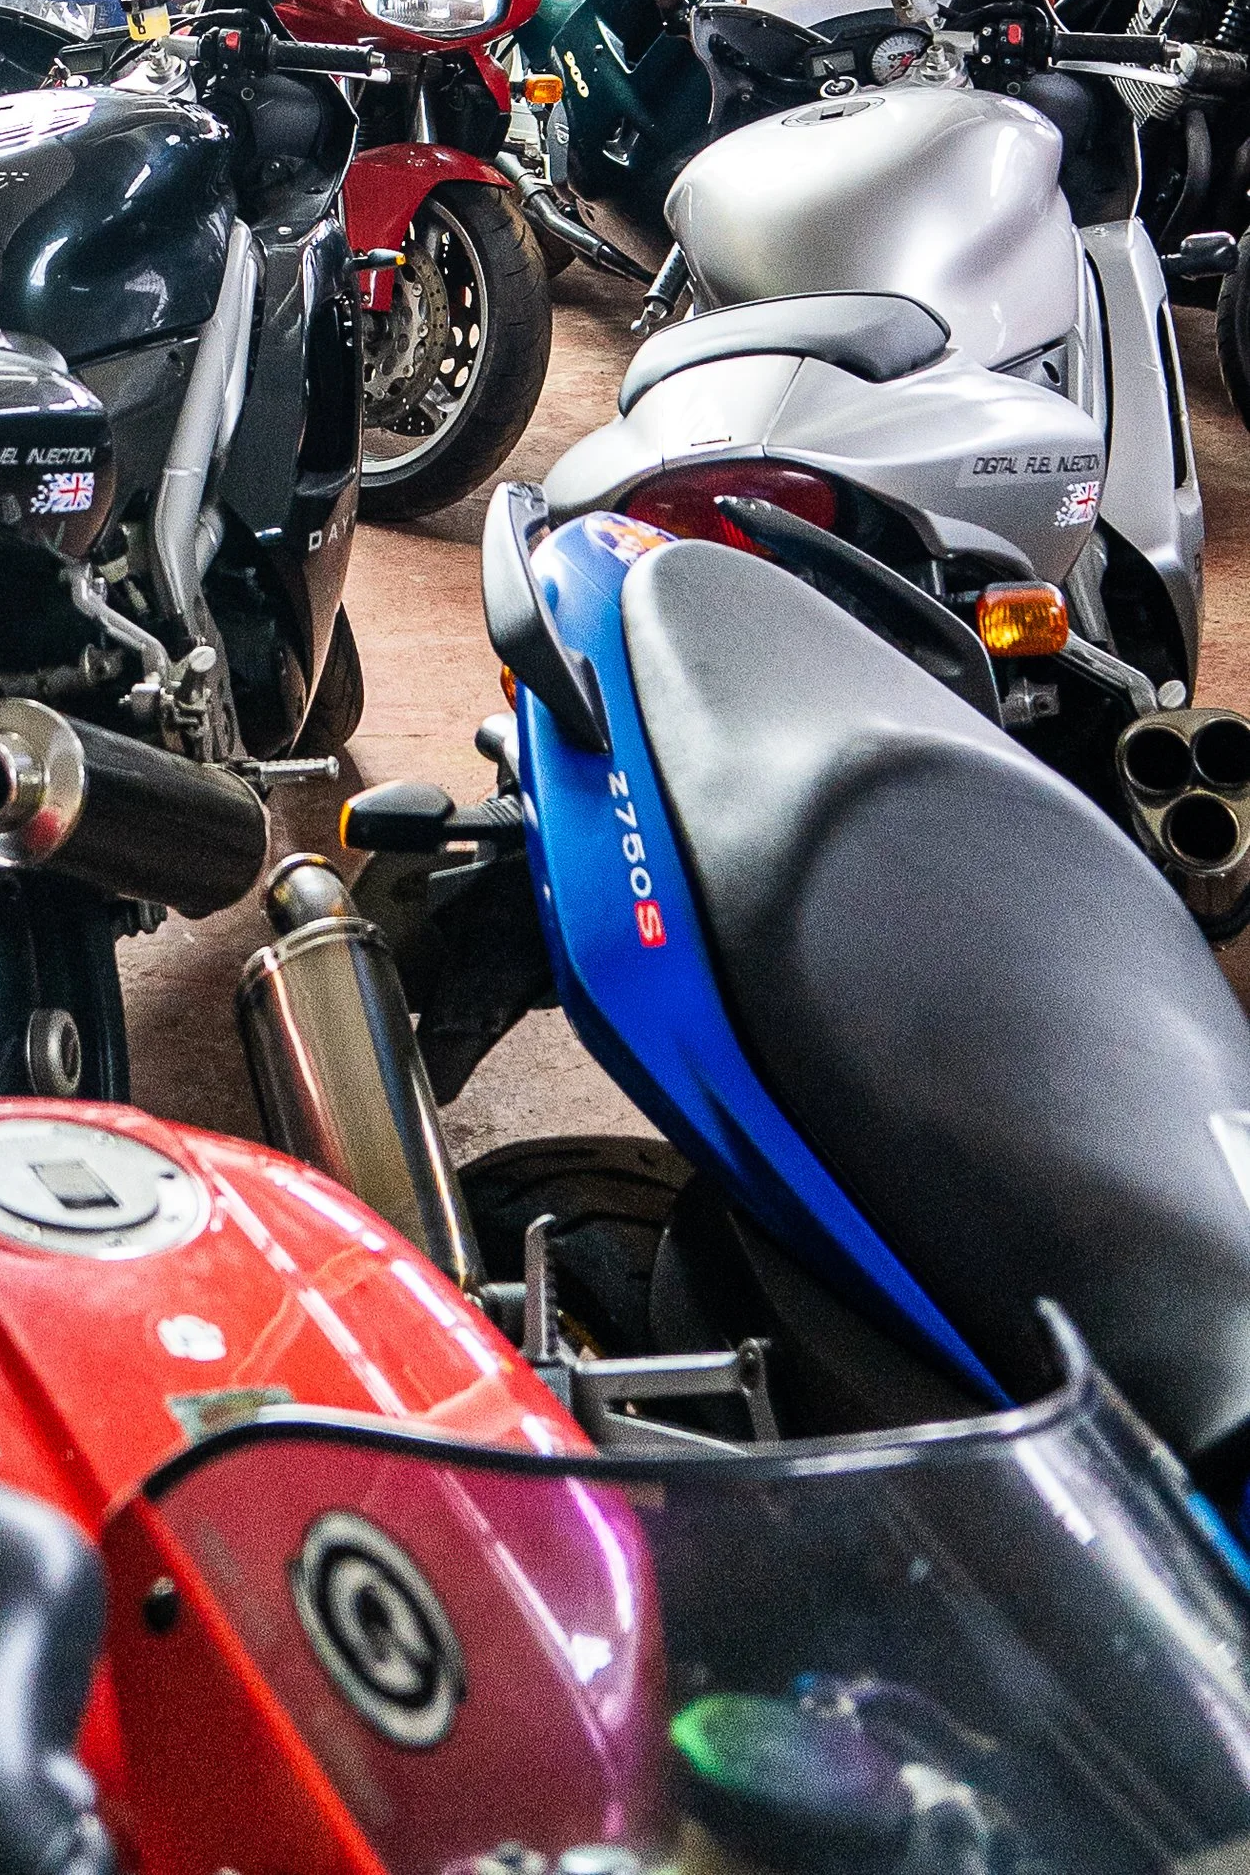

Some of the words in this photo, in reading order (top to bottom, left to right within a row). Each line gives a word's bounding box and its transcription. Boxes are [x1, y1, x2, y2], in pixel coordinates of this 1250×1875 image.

[563, 50, 590, 98] 900
[25, 446, 97, 465] INJECTION
[972, 456, 1018, 475] DIGITAL
[1023, 456, 1052, 474] FUEL
[1055, 453, 1101, 473] INJECTION
[607, 770, 665, 945] Z750S
